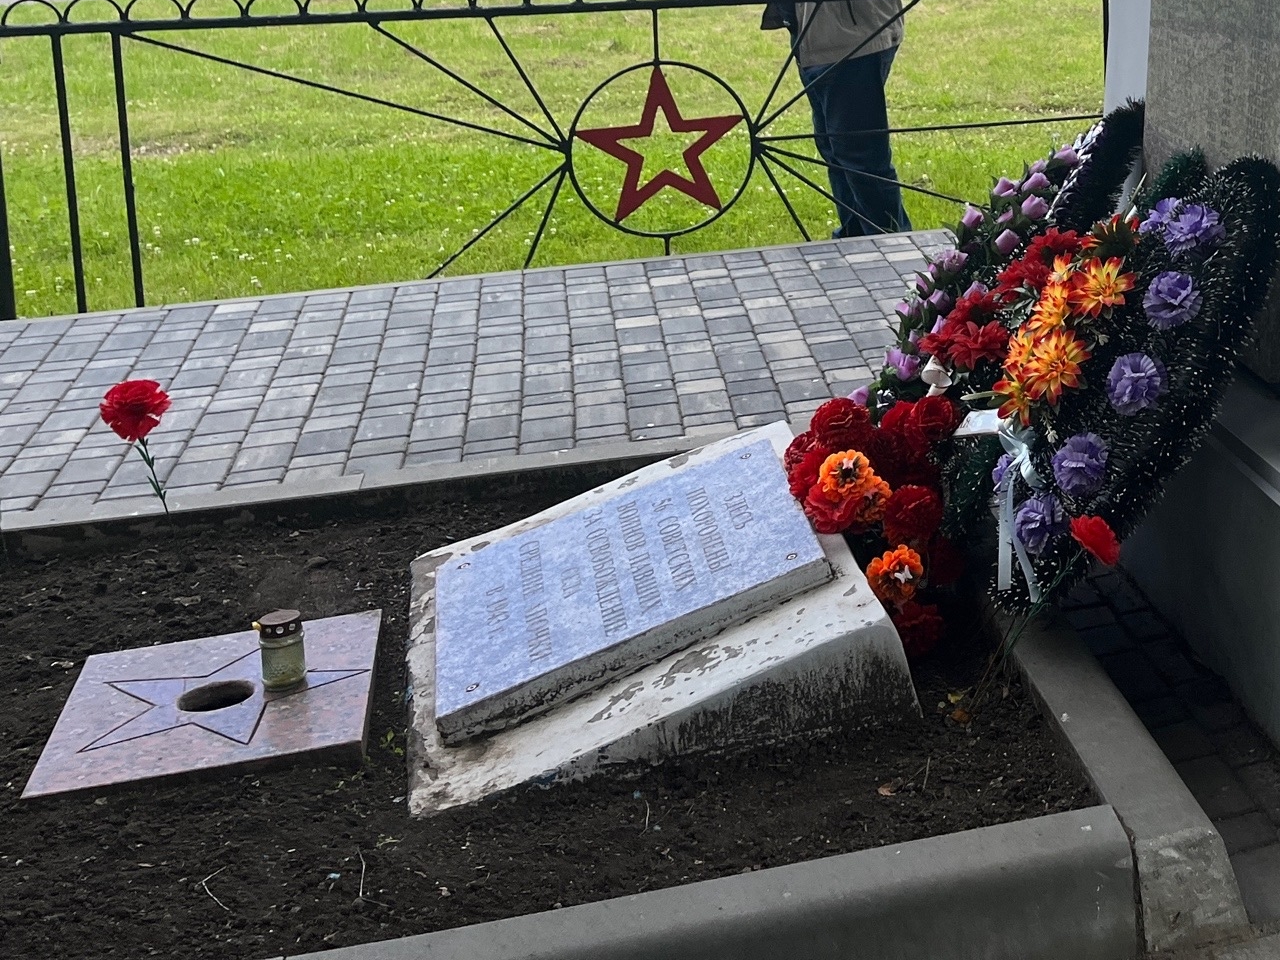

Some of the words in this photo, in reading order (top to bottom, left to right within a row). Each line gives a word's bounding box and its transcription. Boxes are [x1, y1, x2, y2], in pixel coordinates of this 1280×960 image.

[582, 509, 604, 528] ЗА
[617, 500, 647, 551] ВОИНОВ
[652, 498, 674, 513] 56
[686, 485, 732, 574] ПОХОРОНЕНЫ
[721, 490, 754, 530] ЗДЕСЬ
[518, 540, 545, 601] СРЕДНИЕ
[586, 527, 628, 637] ОСВОБОЖДЕНИЕ
[658, 516, 697, 592] СОВЕТСКИХ
[560, 566, 582, 599] СЕЛА
[628, 552, 663, 616] ПАВШИХ
